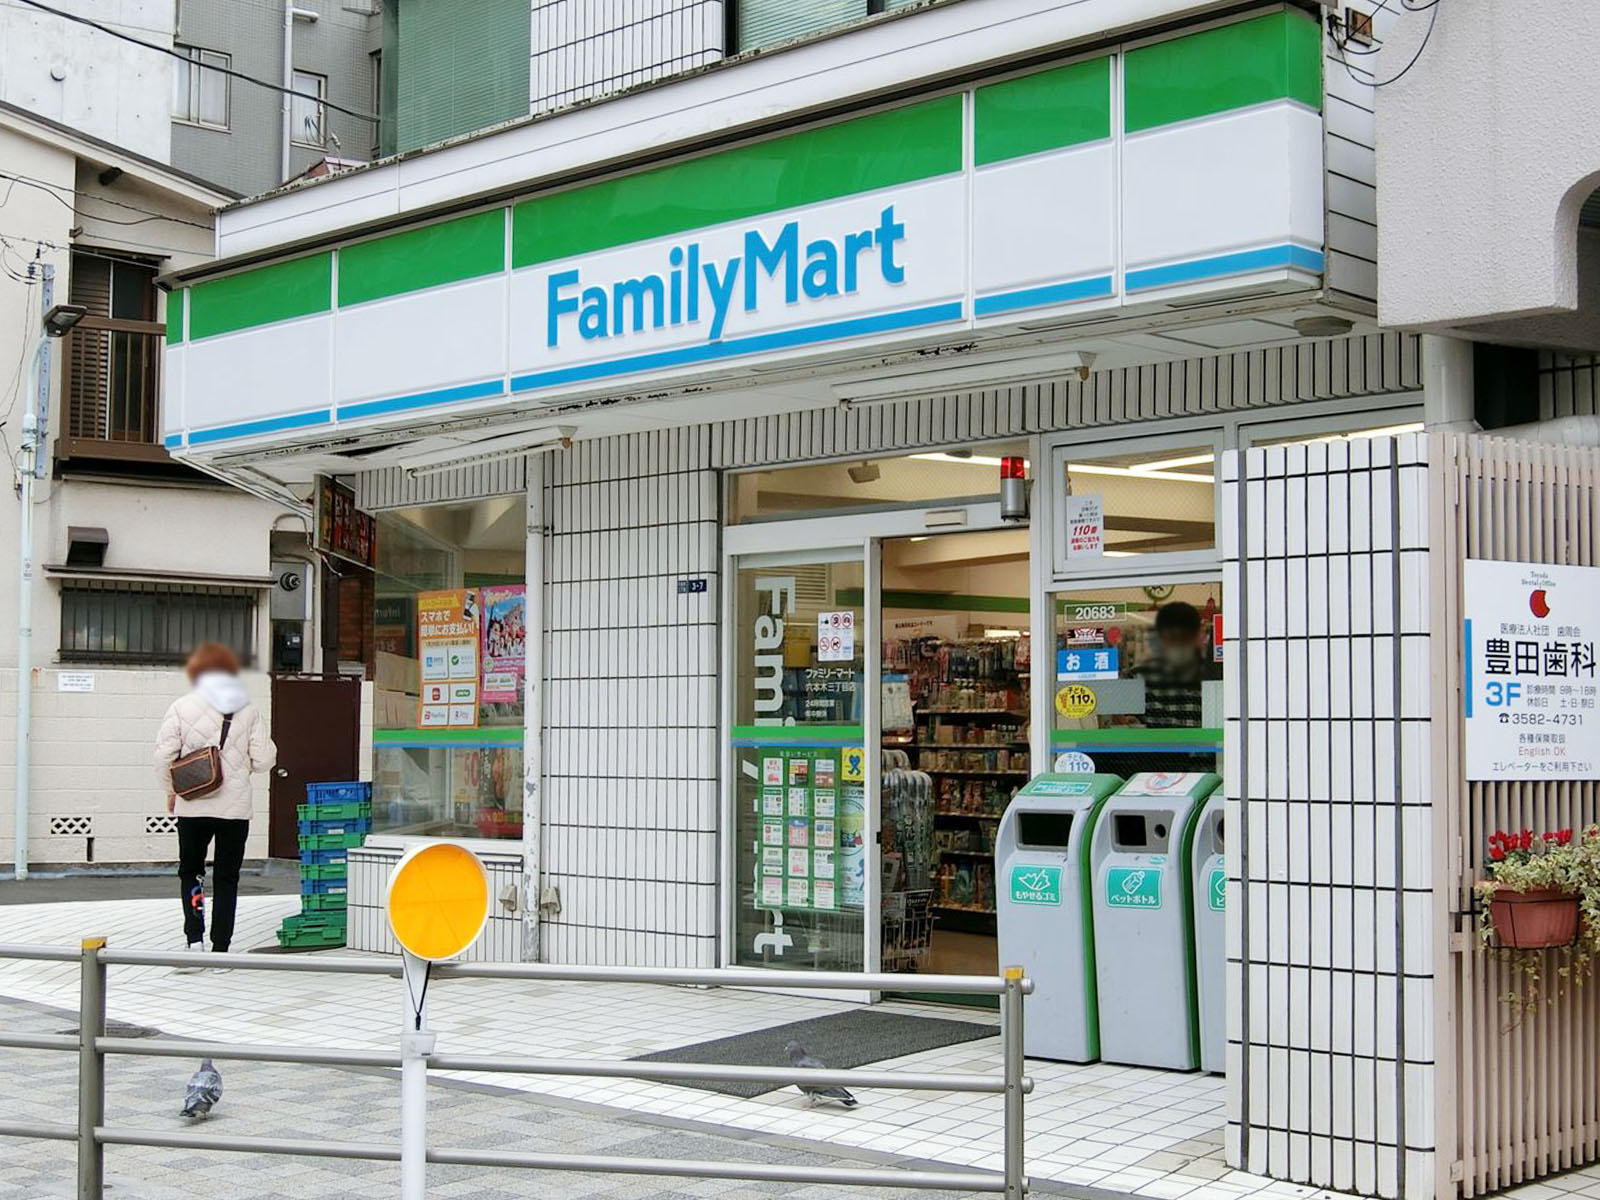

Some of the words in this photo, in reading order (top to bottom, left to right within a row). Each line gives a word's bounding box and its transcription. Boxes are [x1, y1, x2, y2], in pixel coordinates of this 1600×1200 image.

[547, 203, 906, 348] FamilyMart
[1075, 606, 1116, 620] 20683
[1500, 622, 1550, 637] 医療法人社団
[1484, 637, 1597, 679] 豊田歯科
[805, 668, 856, 679] ファミリーマート
[1485, 681, 1522, 707] 3F
[1512, 712, 1585, 726] 3582-4731
[1518, 746, 1545, 759] English
[1554, 747, 1567, 758] OK
[1016, 890, 1057, 902] もやせるゴミ
